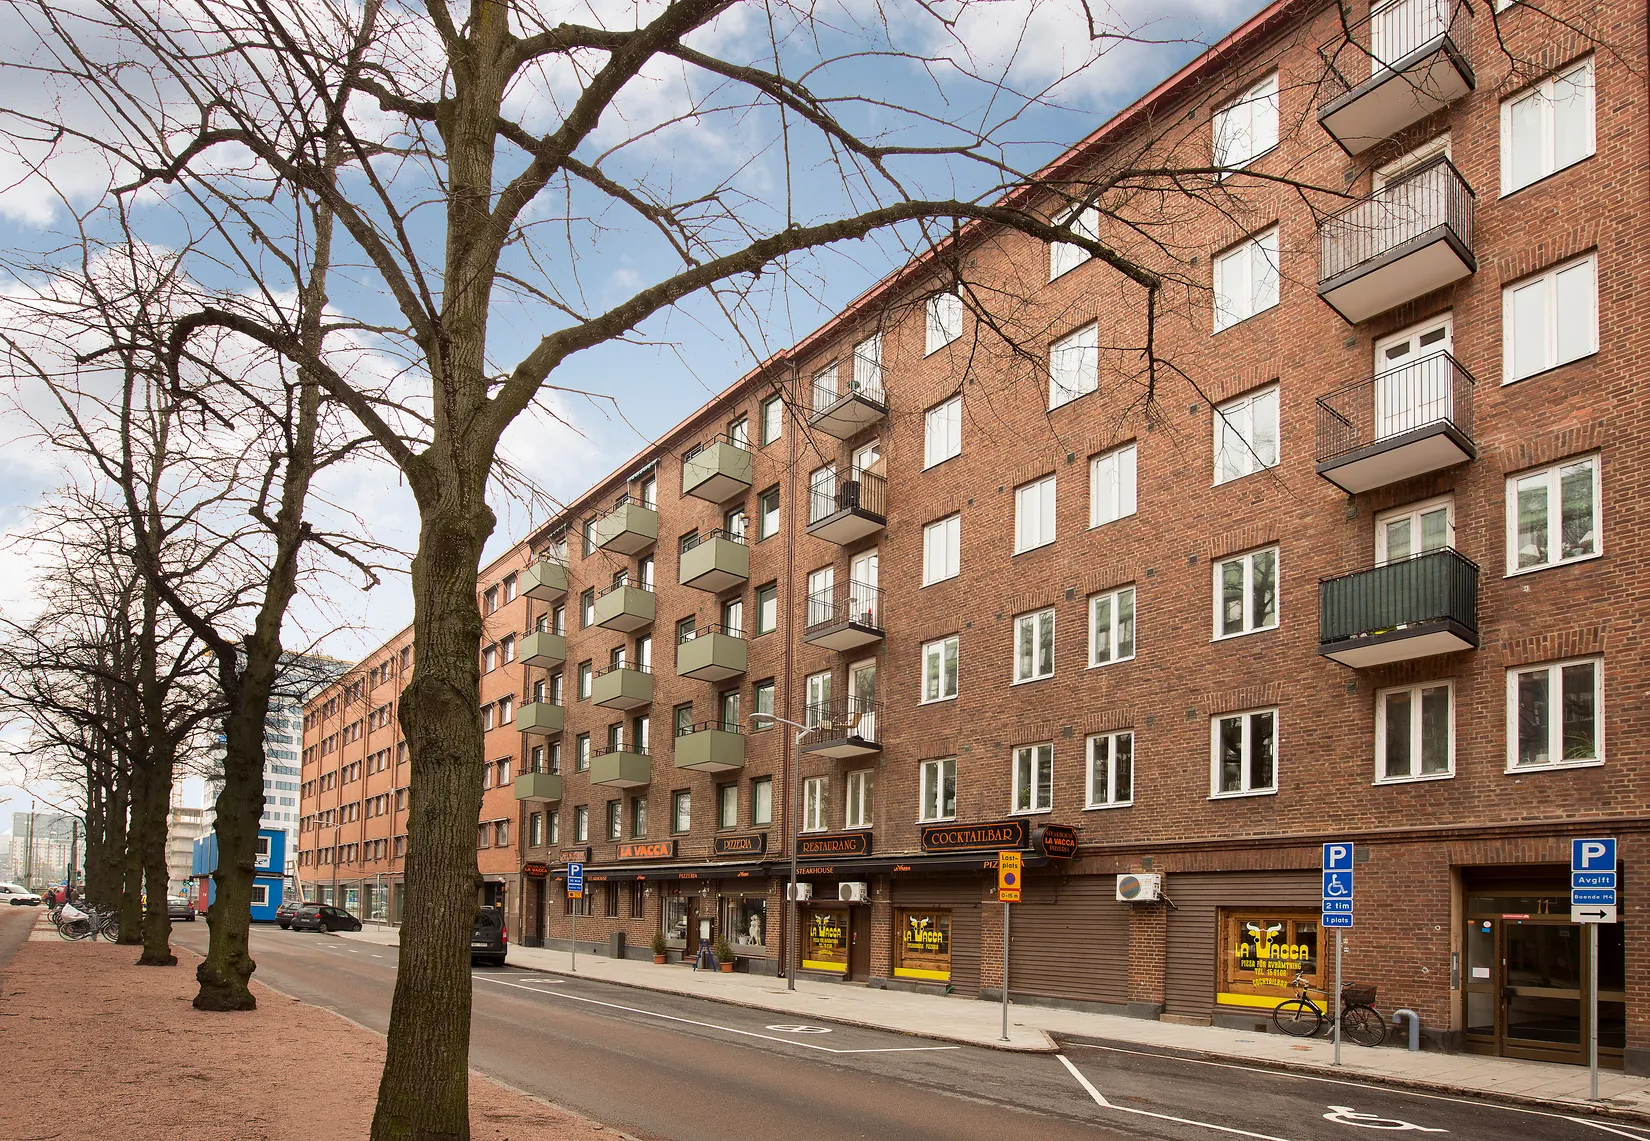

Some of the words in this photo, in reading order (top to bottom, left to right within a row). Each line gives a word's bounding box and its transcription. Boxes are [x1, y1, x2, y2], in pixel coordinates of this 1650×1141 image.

[931, 828, 1012, 844] COCKTAILBAR
[723, 839, 752, 850] PIZZERIA
[803, 839, 857, 852] RESTAURANG
[1054, 838, 1075, 847] VACCA
[620, 846, 632, 857] LA
[633, 843, 668, 856] VACCA
[1581, 842, 1606, 868] P
[1329, 846, 1347, 868] P
[571, 864, 580, 876] P
[1578, 876, 1610, 884] Avgift
[1537, 899, 1550, 914] 11
[1330, 916, 1349, 924] plats
[810, 926, 817, 937] LA
[903, 930, 912, 942] LA
[1235, 943, 1249, 958] LA
[1241, 959, 1255, 968] PIZZA
